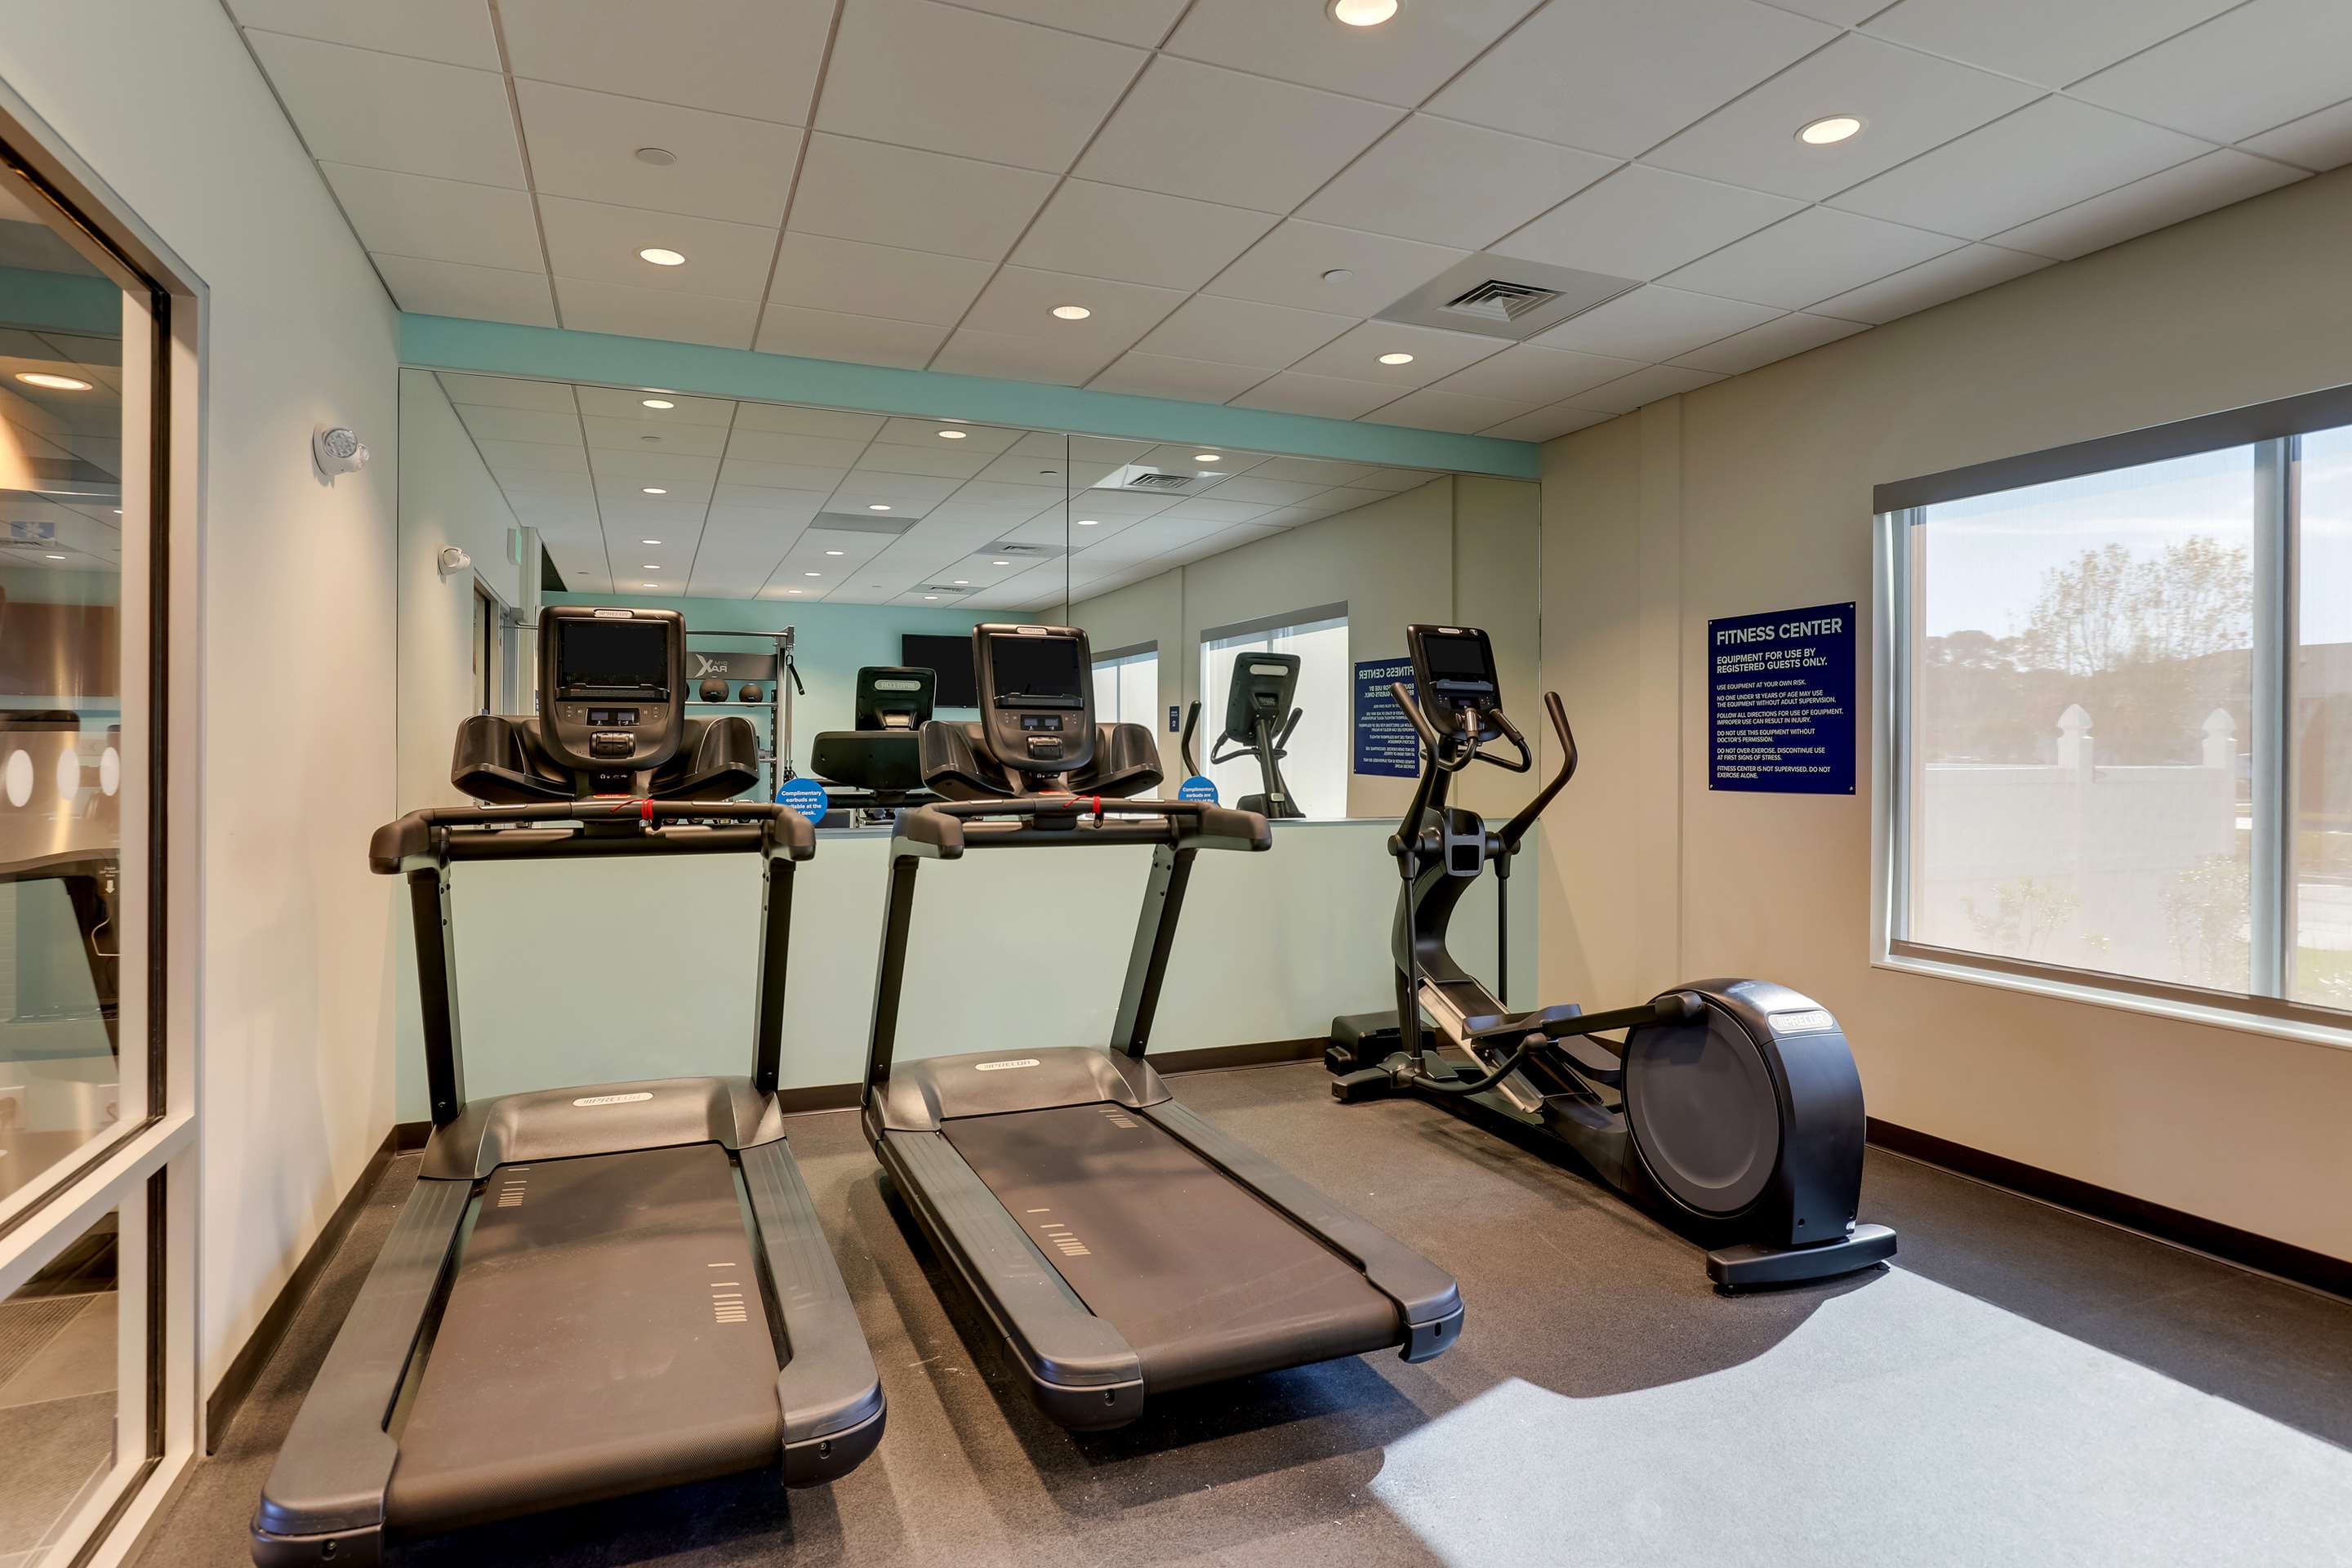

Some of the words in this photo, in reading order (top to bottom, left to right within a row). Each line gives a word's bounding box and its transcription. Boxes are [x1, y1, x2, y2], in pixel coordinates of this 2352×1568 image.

[1717, 626, 1775, 645] FITNESS
[1780, 618, 1842, 638] CENTER
[1717, 653, 1763, 664] EQUIPMENT
[1766, 652, 1782, 660] FOR
[1784, 650, 1802, 658] USE
[1804, 648, 1815, 657] BY
[1717, 662, 1765, 673] REGISTERED
[1767, 660, 1800, 670] GUESTS
[1803, 657, 1827, 667] ONLY.
[1784, 1013, 1824, 1027] PRECOR
